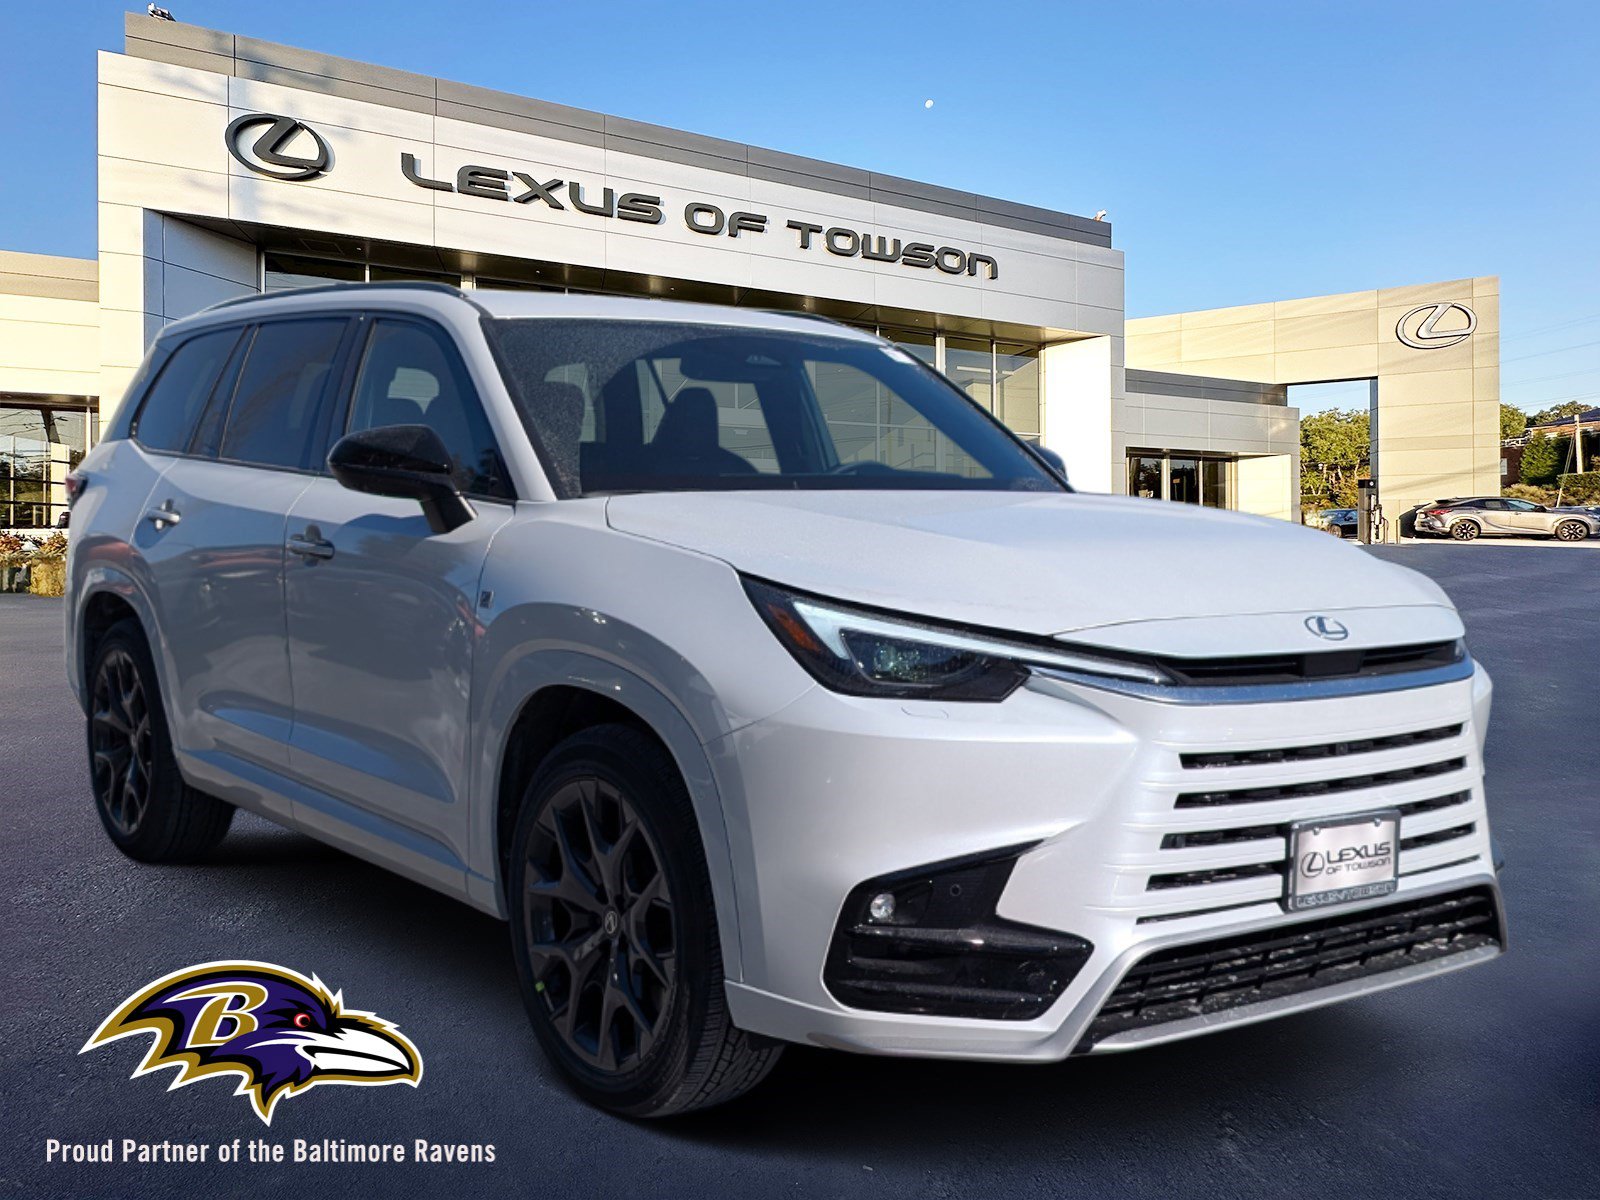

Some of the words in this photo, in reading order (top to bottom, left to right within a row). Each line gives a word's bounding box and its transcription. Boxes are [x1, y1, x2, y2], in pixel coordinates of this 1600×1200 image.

[400, 152, 664, 225] LEXUS
[684, 202, 768, 237] OF
[786, 219, 999, 280] TOWSON
[1326, 841, 1391, 865] LEXUS
[1325, 865, 1342, 875] OF
